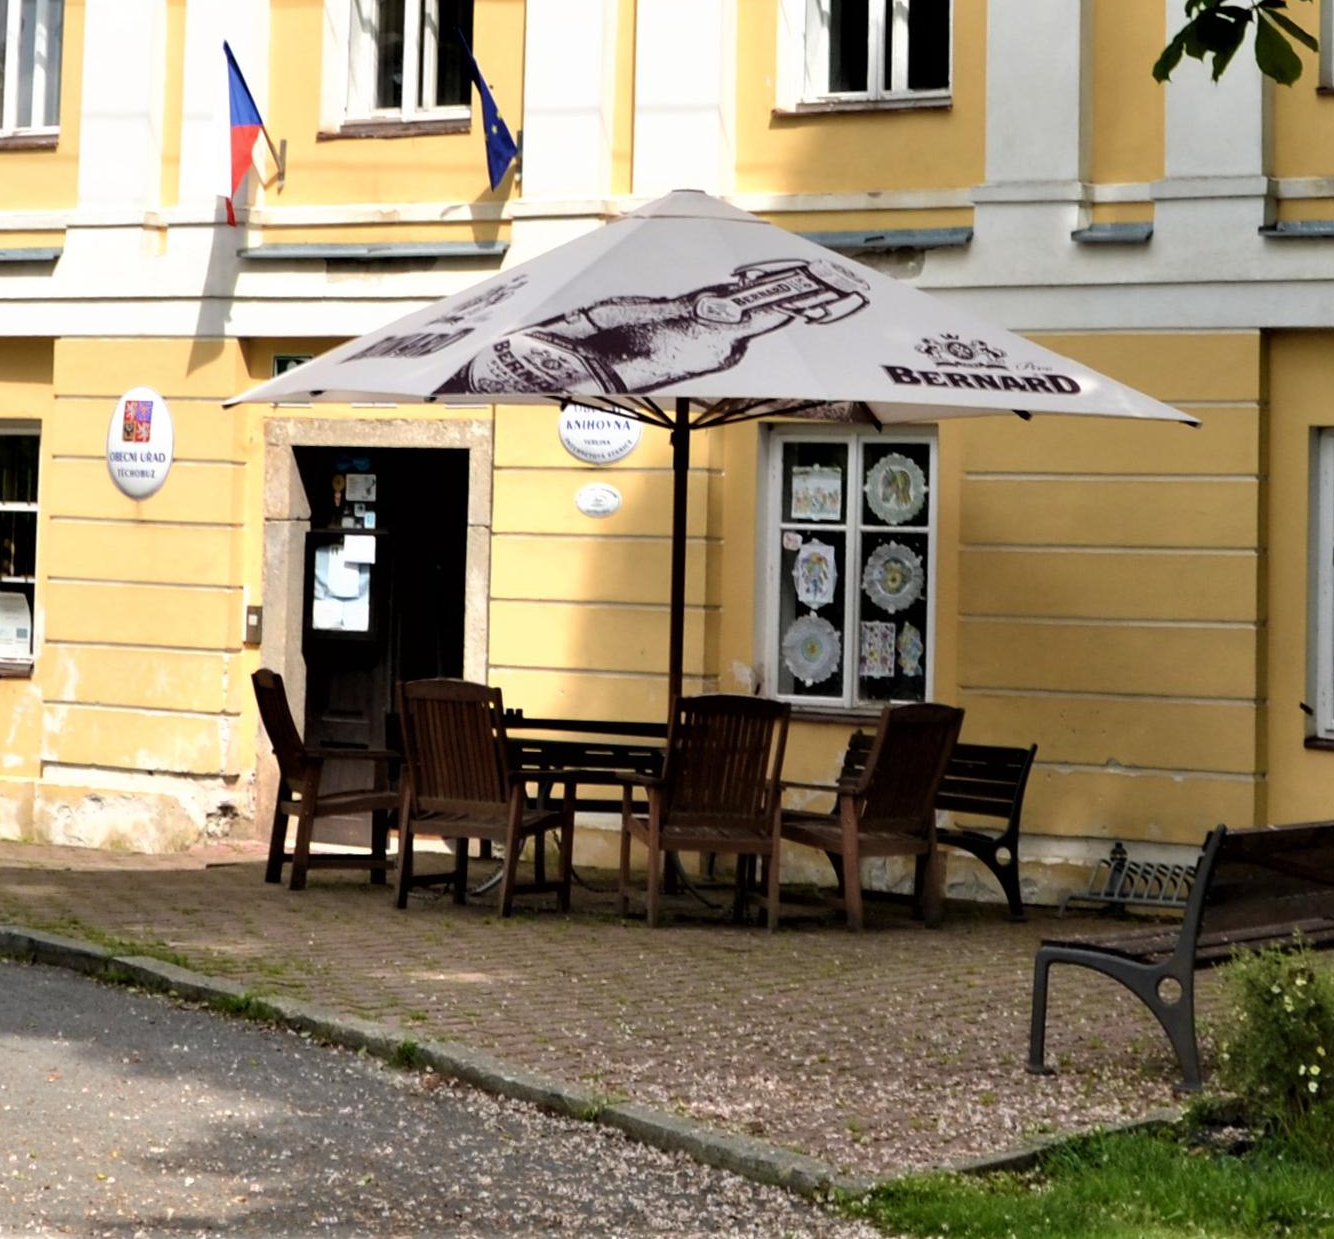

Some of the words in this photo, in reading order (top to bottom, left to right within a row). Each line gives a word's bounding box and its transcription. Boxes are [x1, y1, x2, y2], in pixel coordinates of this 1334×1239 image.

[731, 283, 791, 307] BERNARD
[881, 364, 1082, 395] BERNARD
[566, 420, 631, 431] KNIHOVNA
